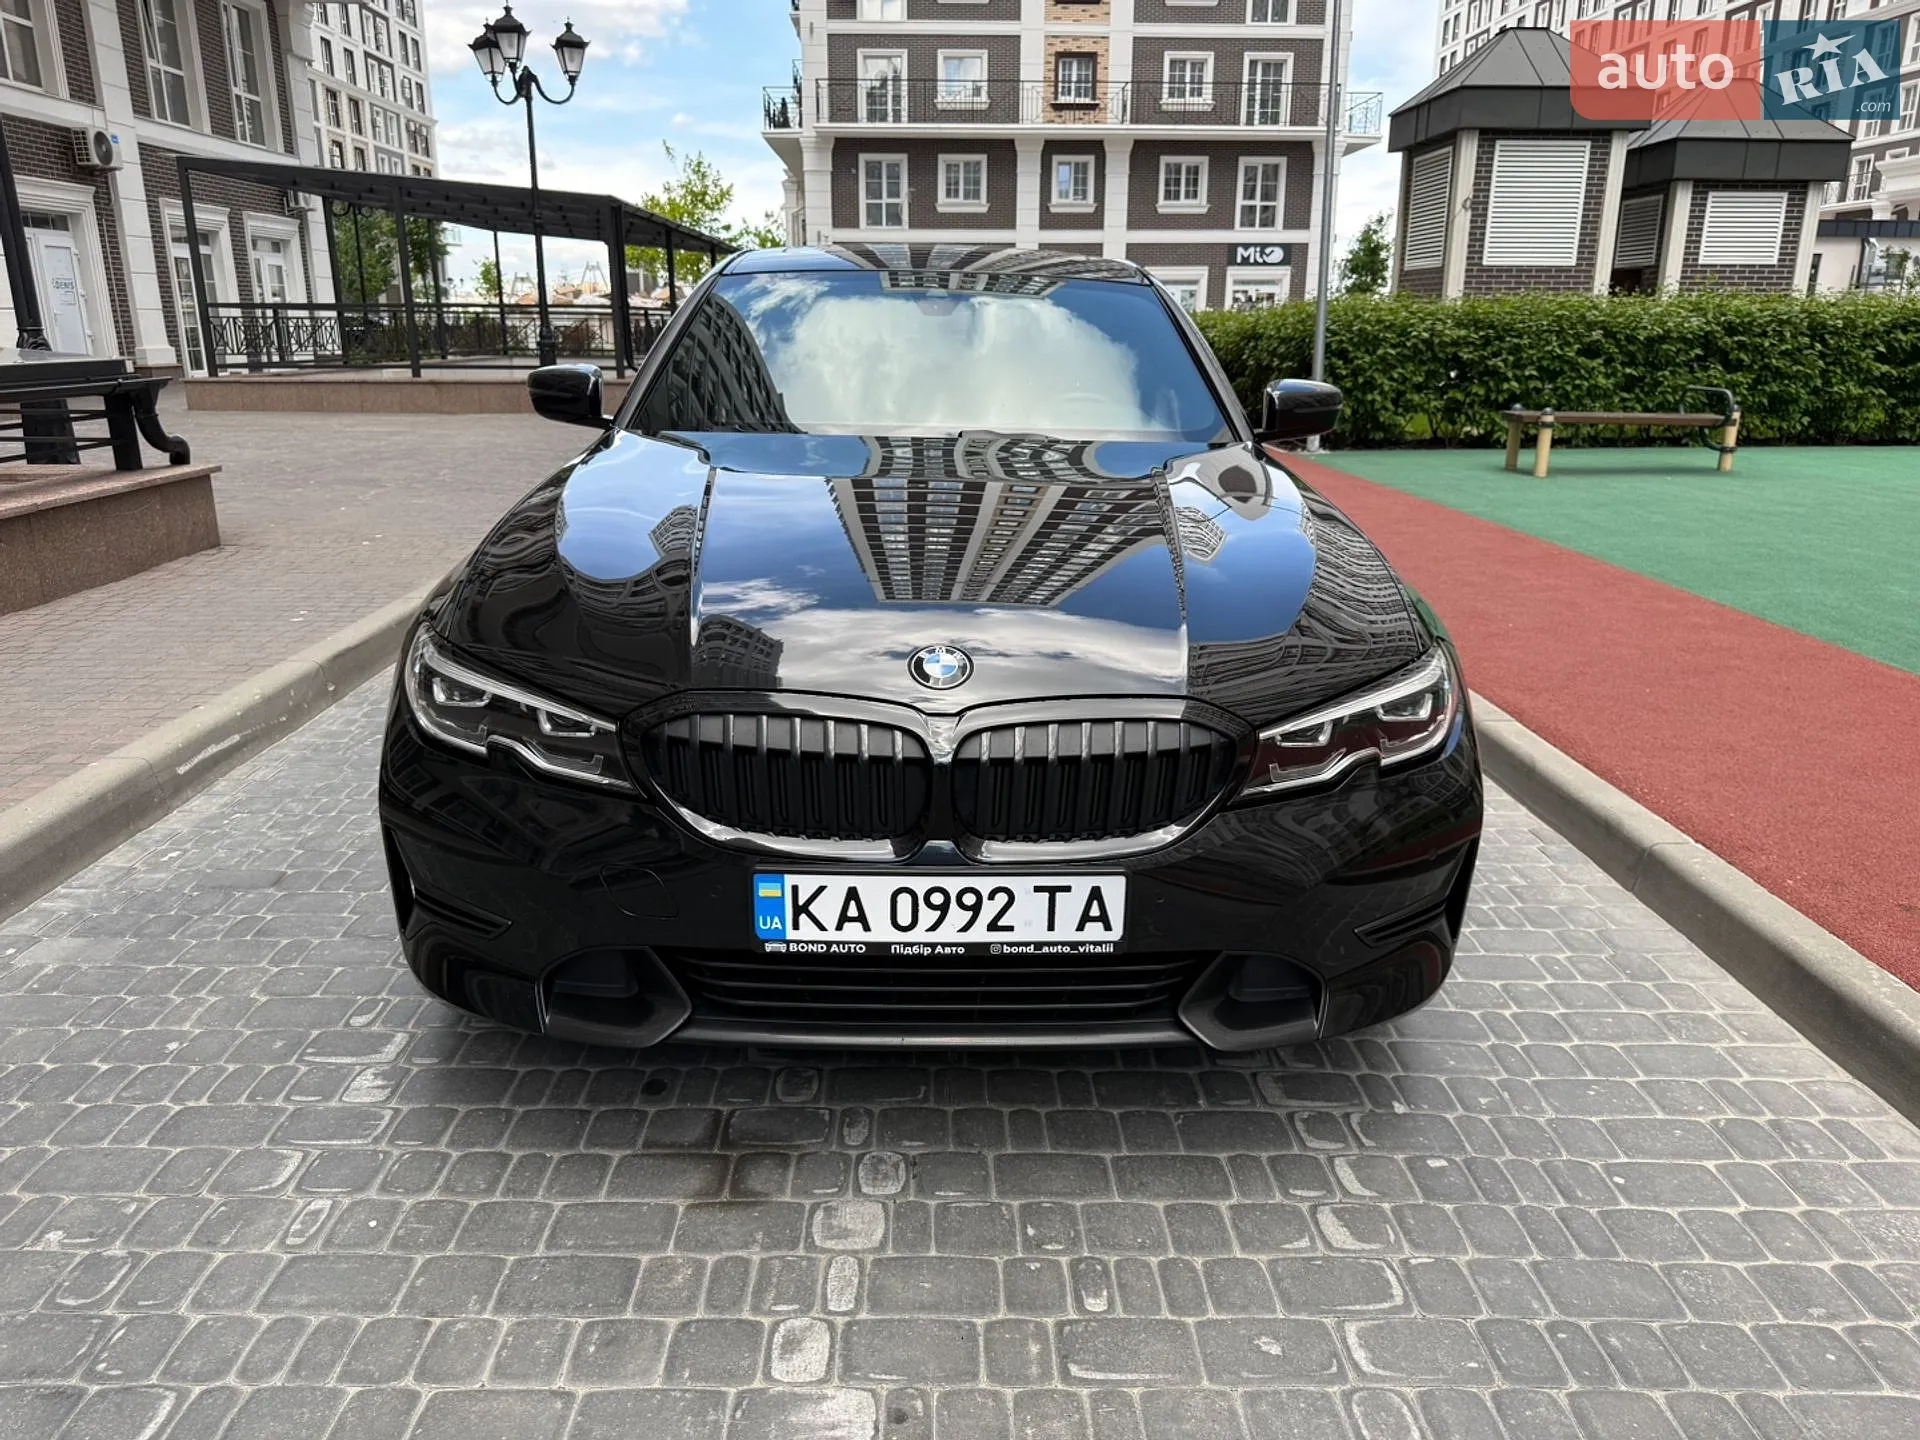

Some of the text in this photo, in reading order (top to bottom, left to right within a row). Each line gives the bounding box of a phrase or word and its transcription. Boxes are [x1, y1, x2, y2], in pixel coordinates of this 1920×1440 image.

[790, 884, 1114, 933] KA 0992 TA
[759, 915, 782, 930] UA
[789, 943, 866, 953] BOND AUTO
[891, 944, 965, 956] Підбір Авто
[1003, 943, 1114, 954] bond_auto_vitalii
